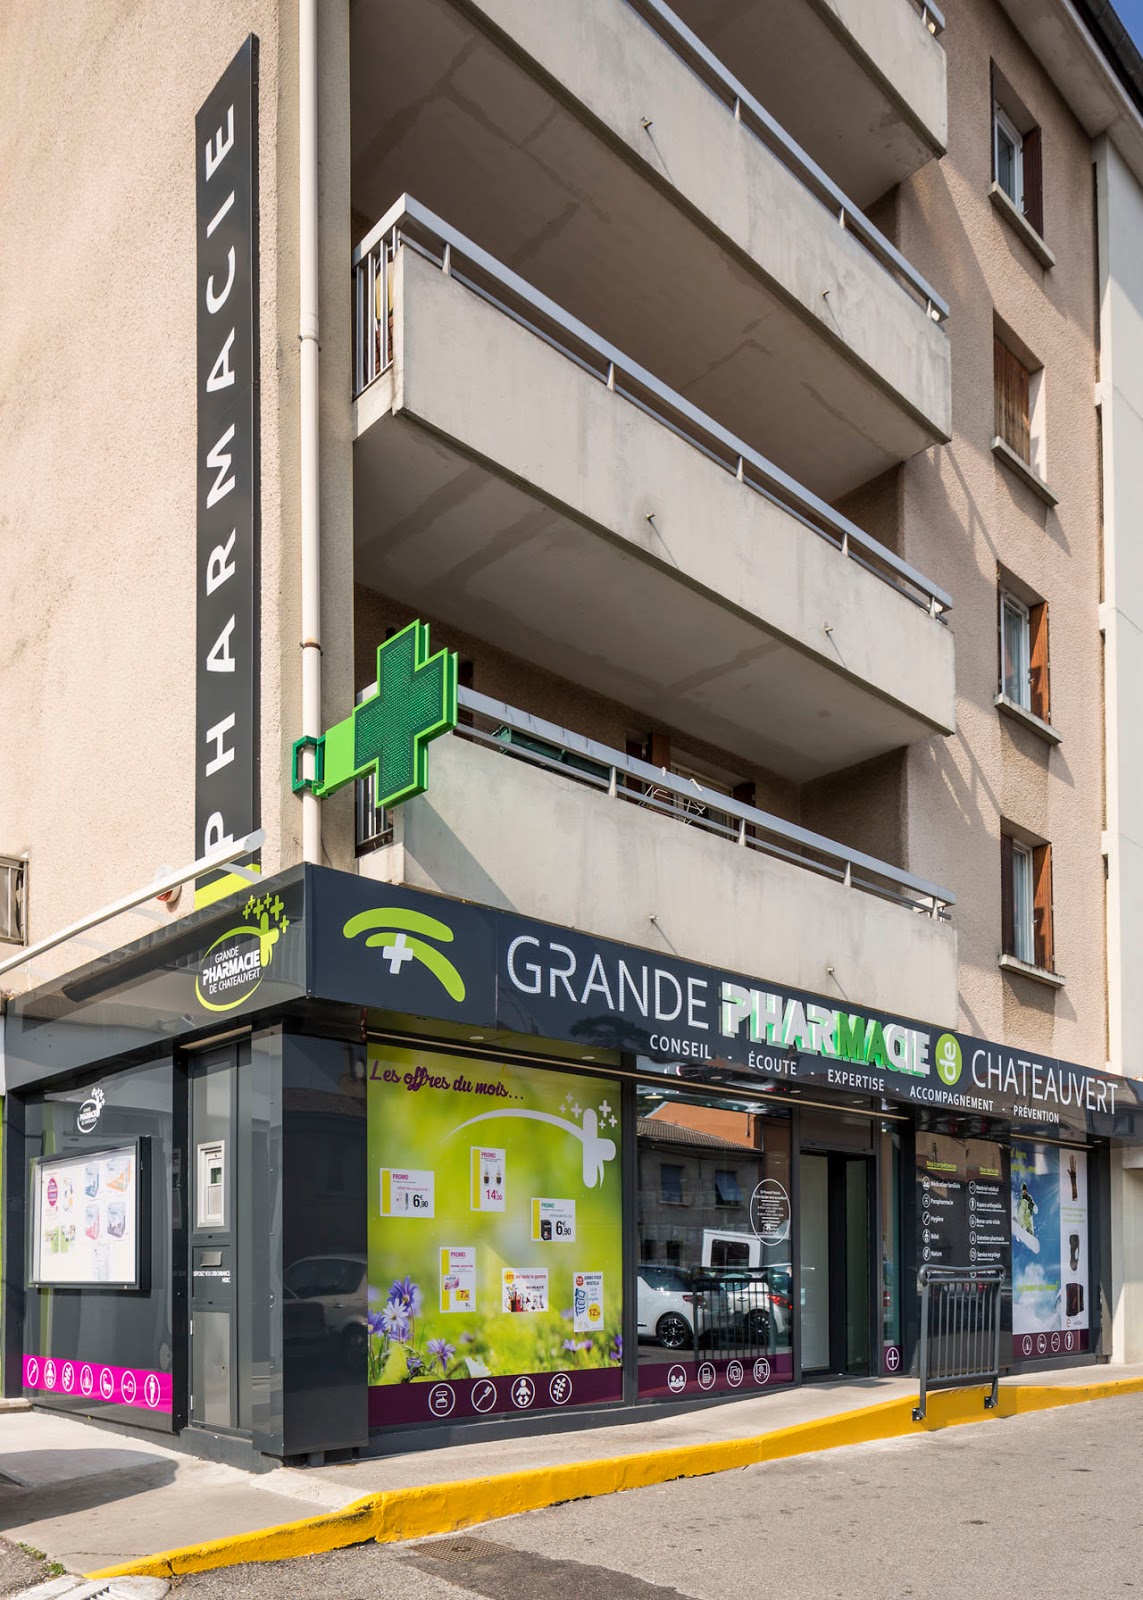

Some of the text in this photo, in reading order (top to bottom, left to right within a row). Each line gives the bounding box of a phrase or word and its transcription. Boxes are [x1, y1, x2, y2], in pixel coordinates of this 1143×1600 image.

[204, 103, 236, 857] PHARMACIE
[202, 949, 261, 986] PHARMACIE
[214, 946, 240, 964] GRANDE
[208, 967, 261, 995] DE CHATEAUVERT
[506, 935, 1119, 1115] GRANDE PHARMACIE de CHATEAUVERT
[369, 1060, 402, 1083] Les
[403, 1066, 451, 1092] offres
[453, 1075, 473, 1092] du
[649, 1034, 1060, 1124] CONSEIL ÉCOUTE EXPERTISE ACCOMPAGNEMENT PRÉVENTION
[481, 1151, 497, 1159] PROMO
[392, 1173, 409, 1181] PROMO
